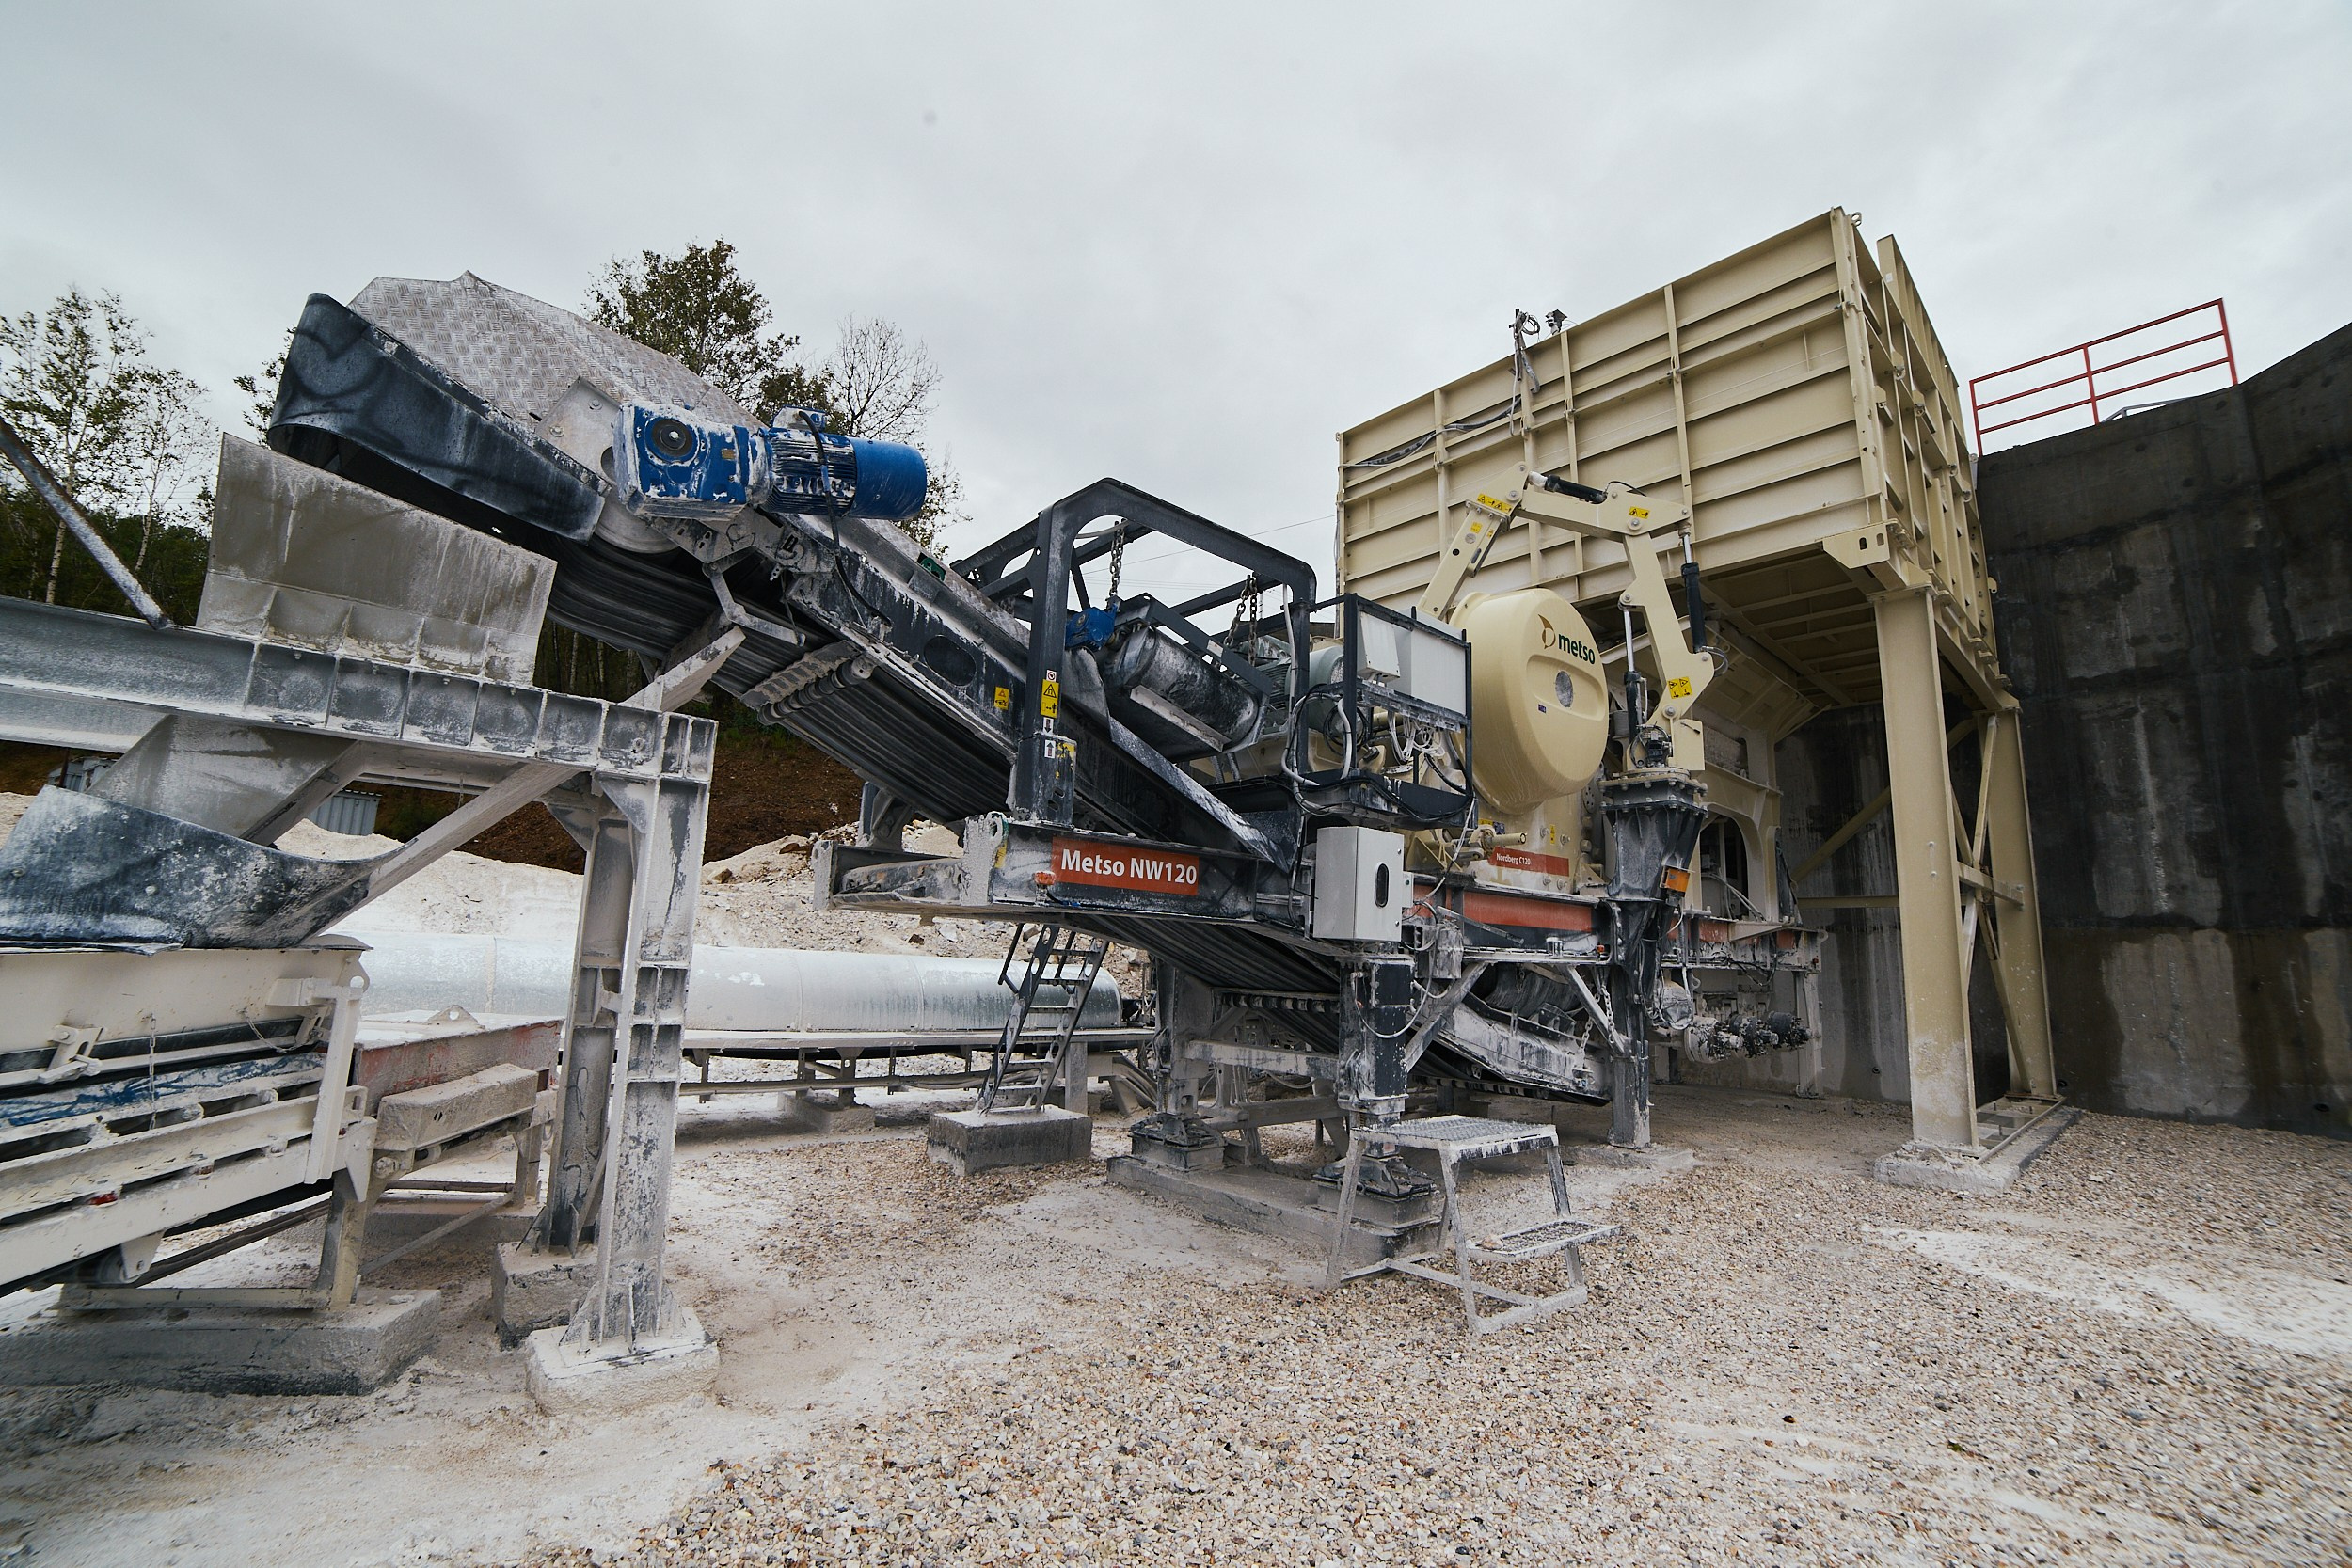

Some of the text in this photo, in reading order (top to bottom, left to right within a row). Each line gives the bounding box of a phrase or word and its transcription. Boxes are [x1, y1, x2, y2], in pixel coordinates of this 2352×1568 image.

[1558, 634, 1596, 664] metso
[1061, 848, 1197, 884] Metso NW120
[1496, 853, 1531, 865] Nordberg C120
